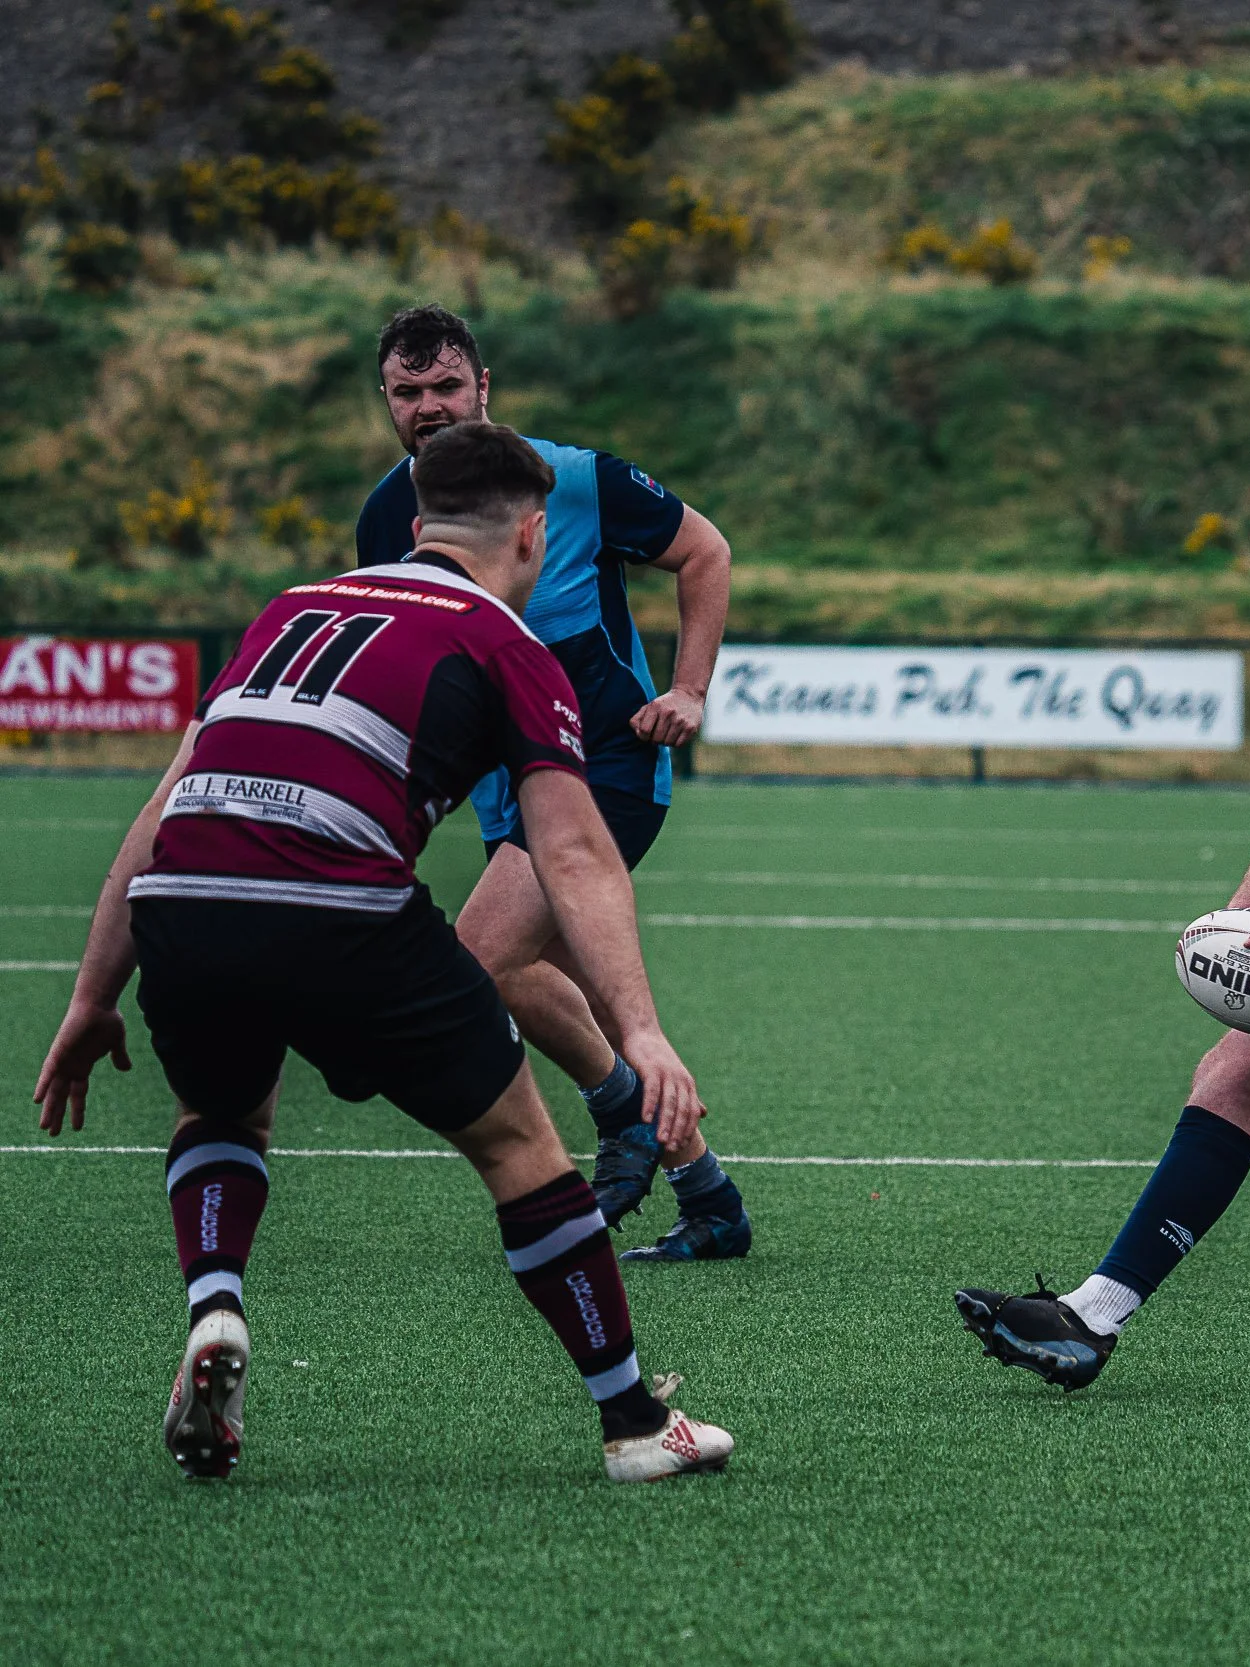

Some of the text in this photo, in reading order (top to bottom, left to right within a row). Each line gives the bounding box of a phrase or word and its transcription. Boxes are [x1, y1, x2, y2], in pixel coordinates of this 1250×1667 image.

[239, 608, 395, 706] 11
[1008, 665, 1087, 720] The
[1101, 664, 1225, 732] Quay
[224, 778, 307, 808] FARRELL
